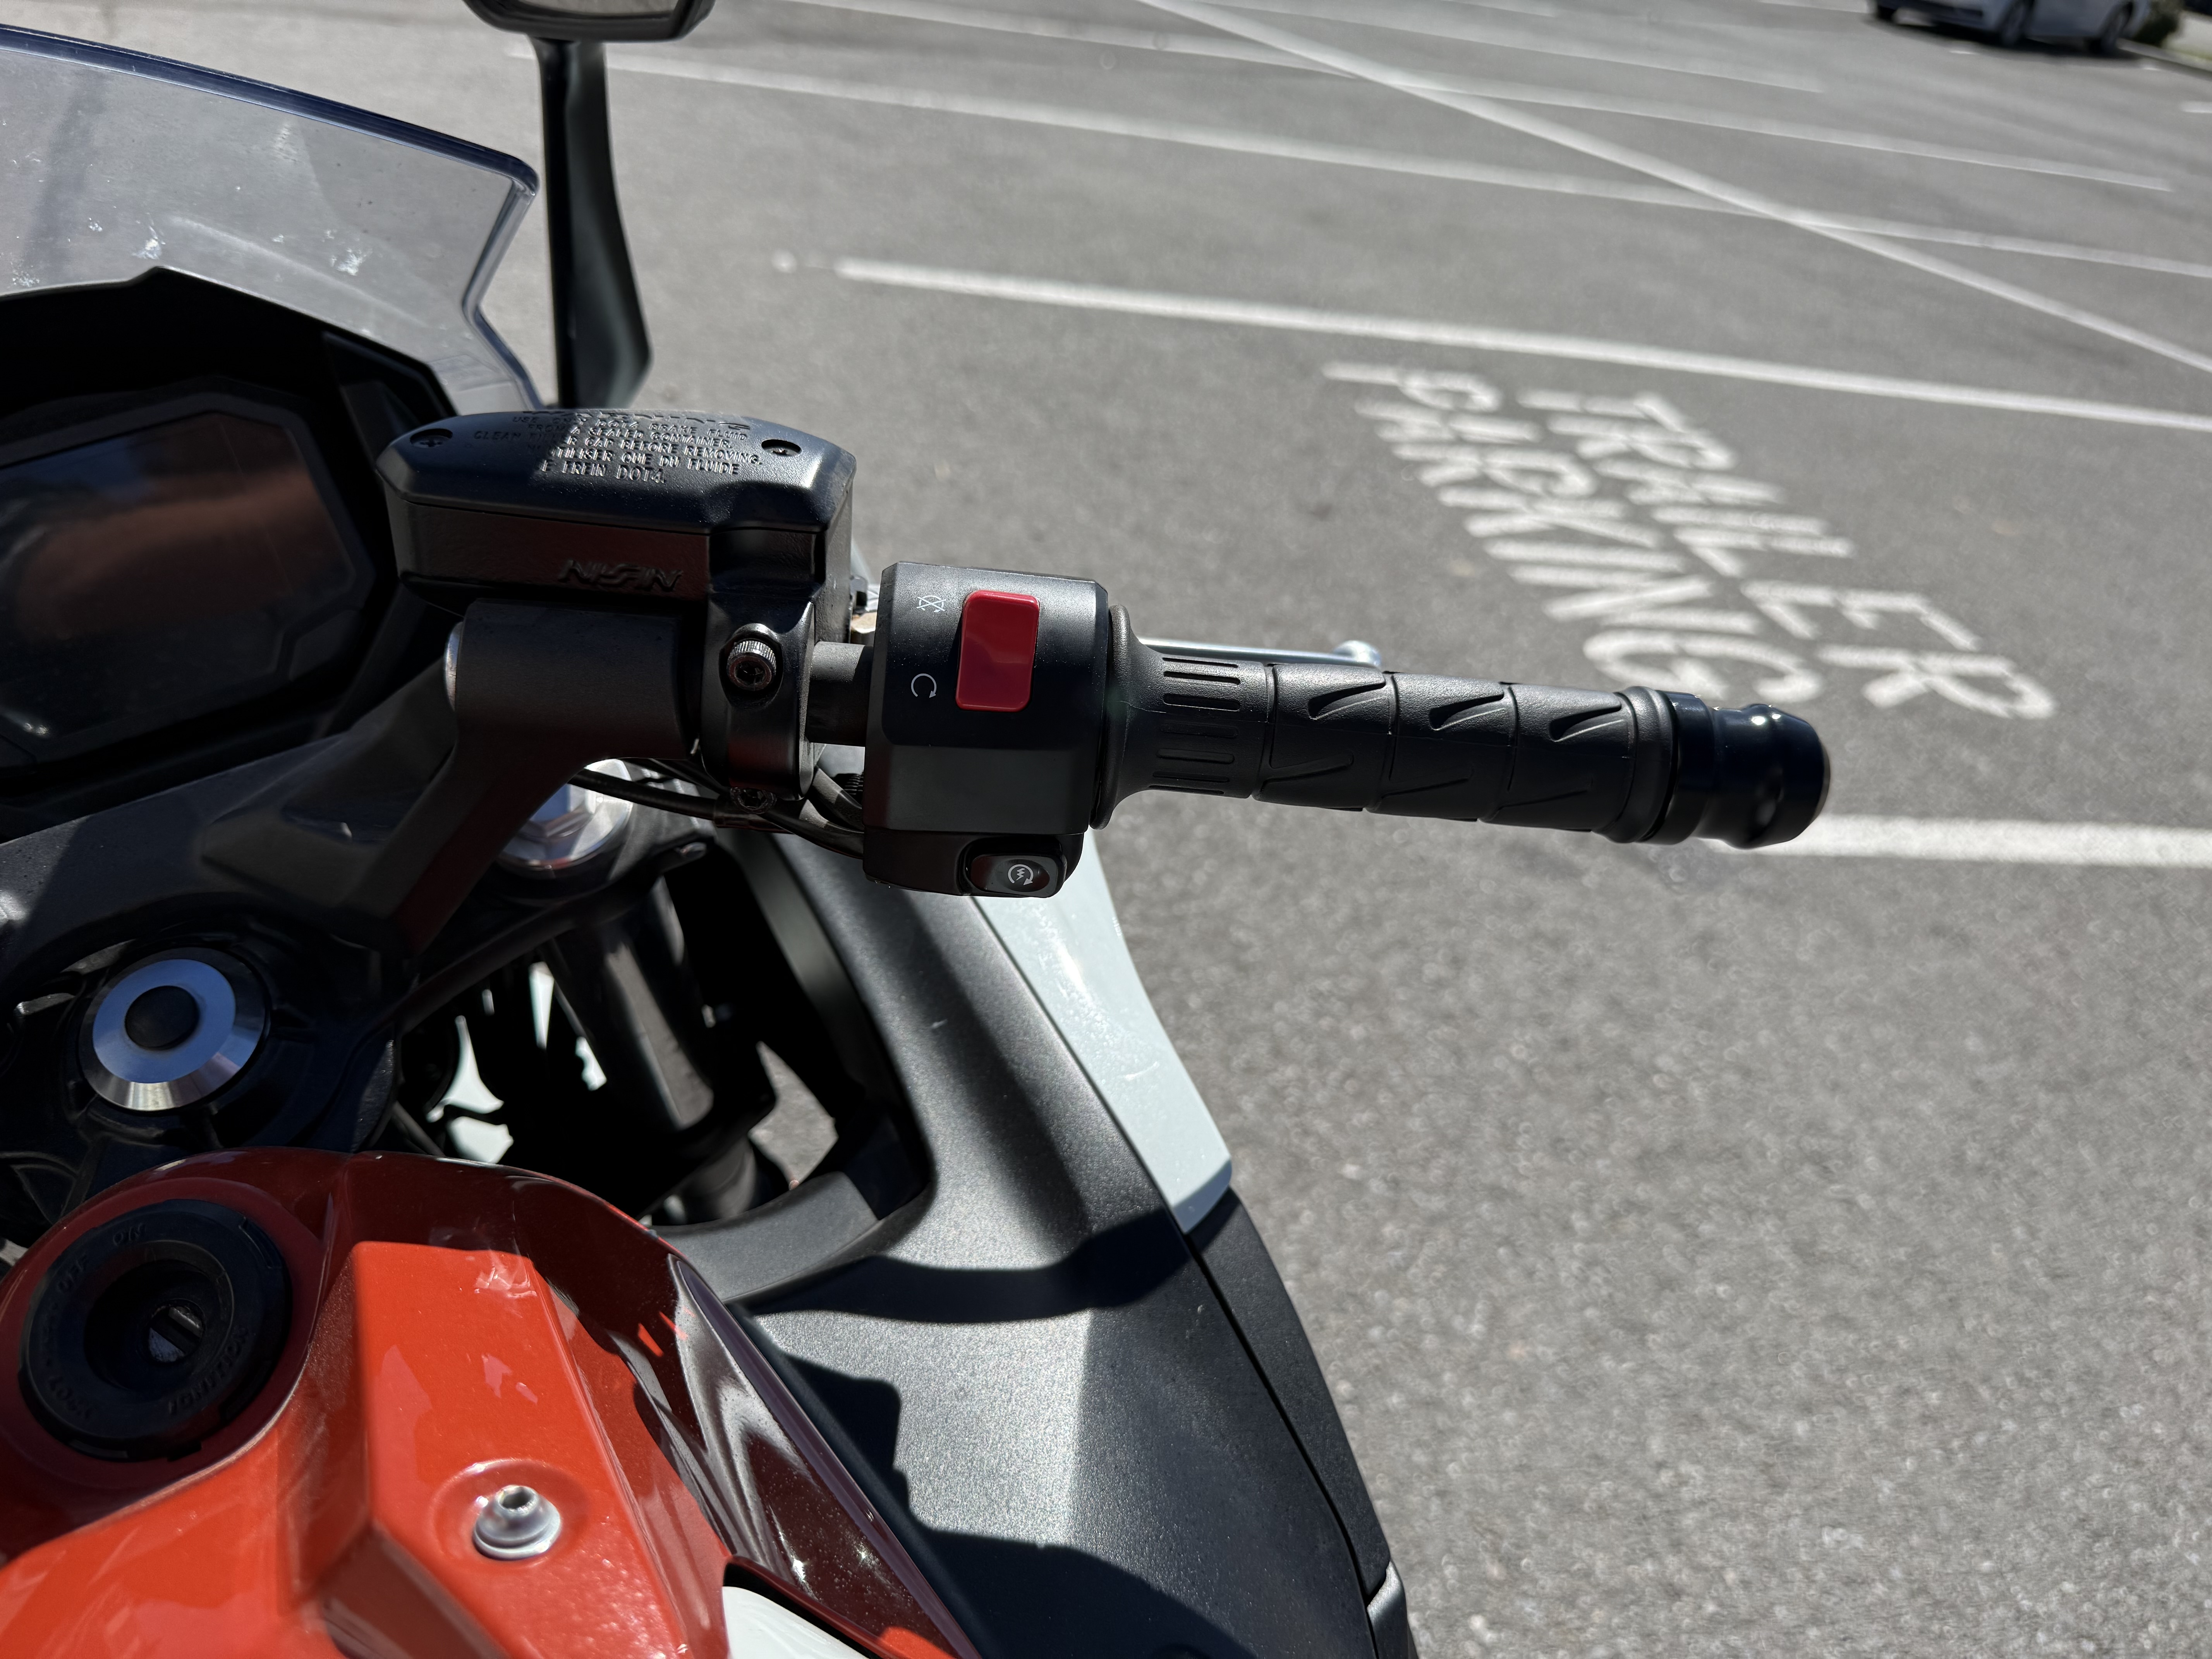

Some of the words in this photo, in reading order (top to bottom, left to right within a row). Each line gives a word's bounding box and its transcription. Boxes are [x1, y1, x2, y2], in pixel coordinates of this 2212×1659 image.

[474, 431, 521, 440] CLEAN
[585, 437, 614, 448] CAP
[620, 439, 678, 454] BEFORE
[528, 424, 566, 433] FROM
[570, 426, 580, 435] A
[588, 427, 644, 438] SEALED
[649, 423, 697, 434] BRAKE
[707, 429, 747, 440] FLUID
[562, 460, 606, 476] FREIN
[621, 451, 653, 465] QUE
[659, 455, 680, 468] DU
[688, 458, 740, 475] FLUIDE
[1321, 360, 1824, 704] PARKING
[1519, 391, 2056, 720] TRAILER
[558, 559, 683, 592] NISSIN
